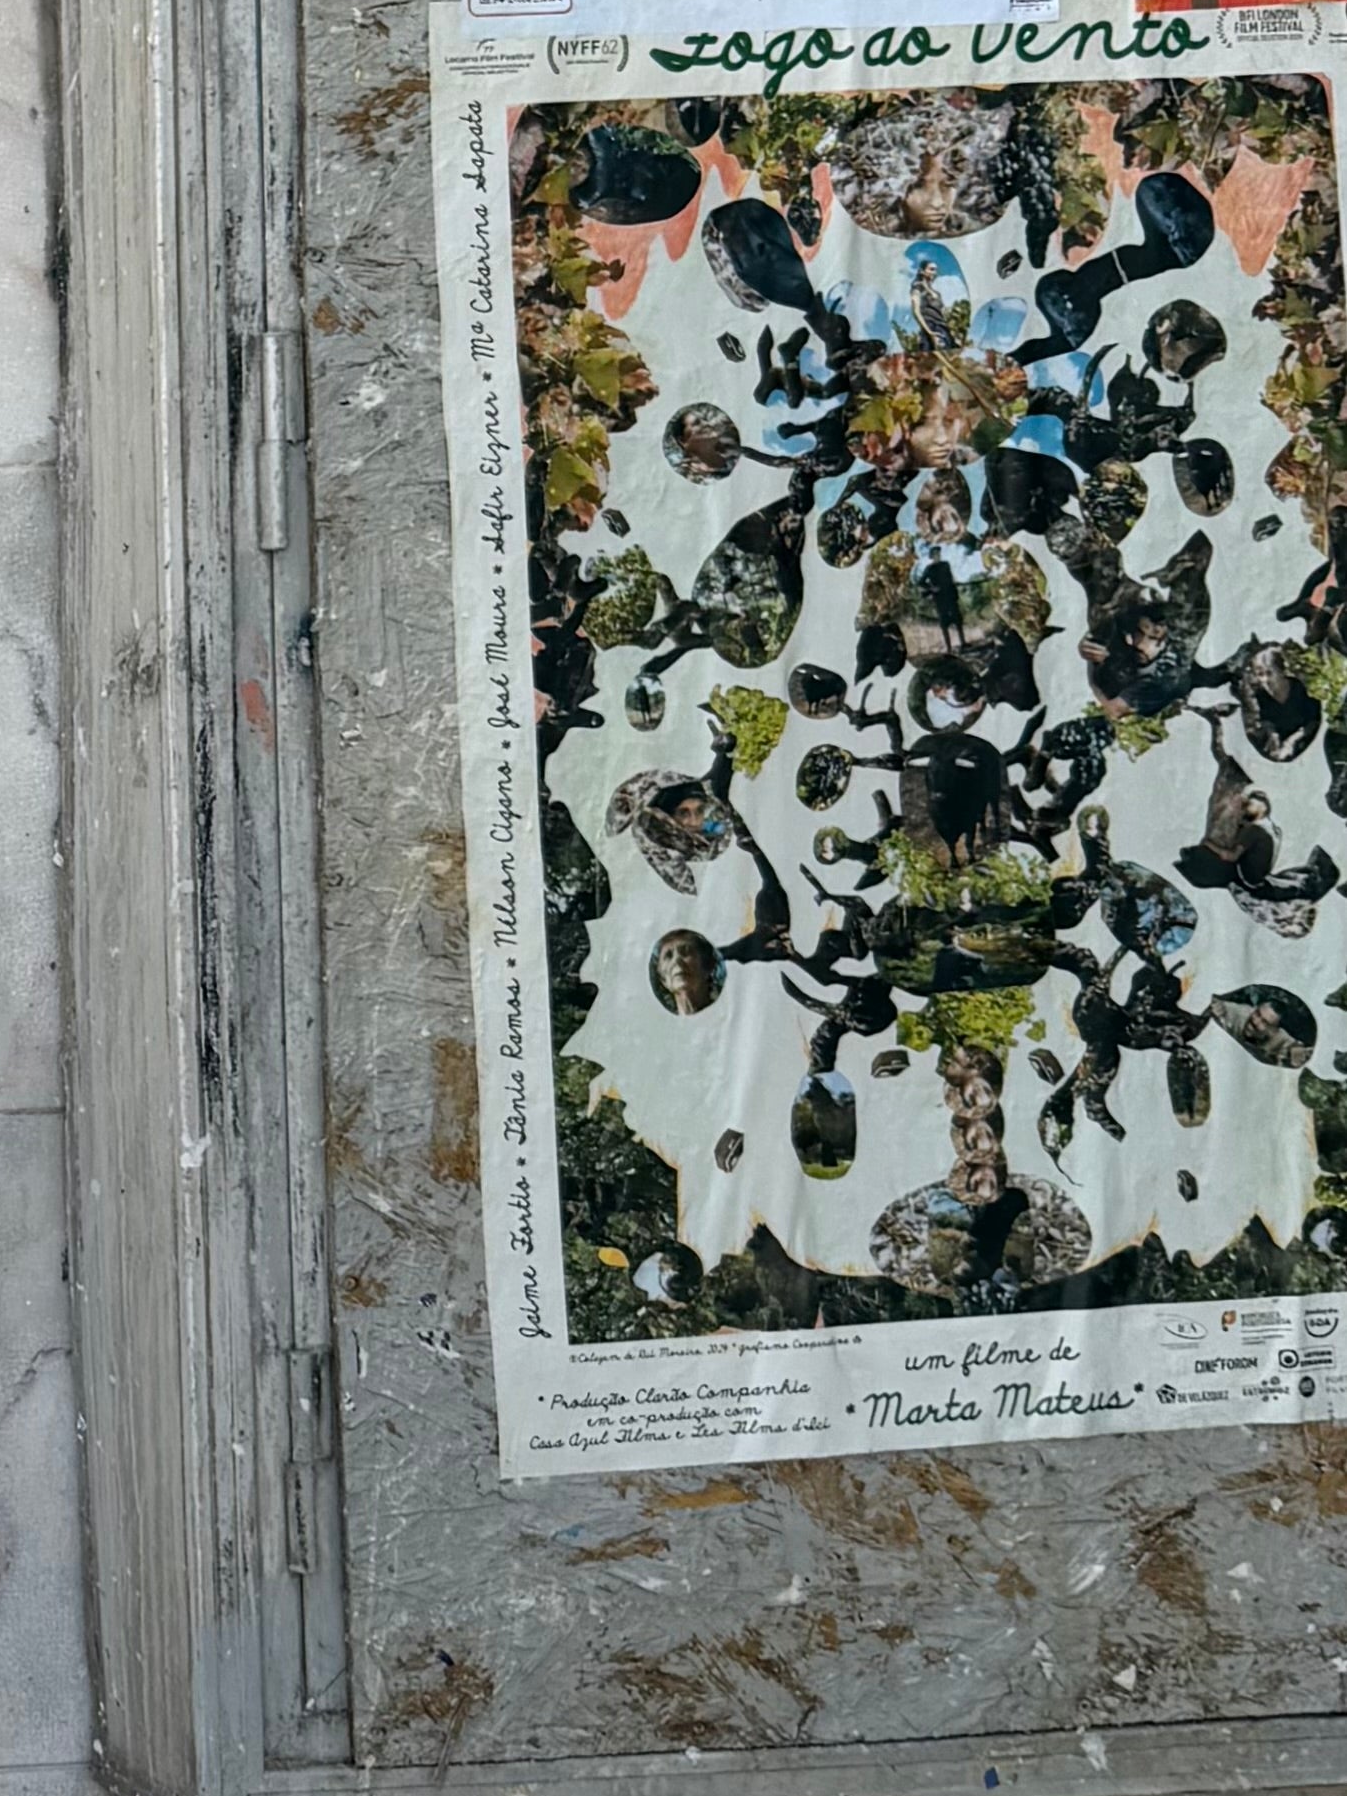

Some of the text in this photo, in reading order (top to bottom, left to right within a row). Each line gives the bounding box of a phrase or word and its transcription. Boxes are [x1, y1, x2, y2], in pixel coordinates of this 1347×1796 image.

[905, 1342, 1081, 1379] um filme de
[550, 1379, 811, 1413] Produção Clarão Companhia
[862, 1384, 1134, 1429] Marta Mateus
